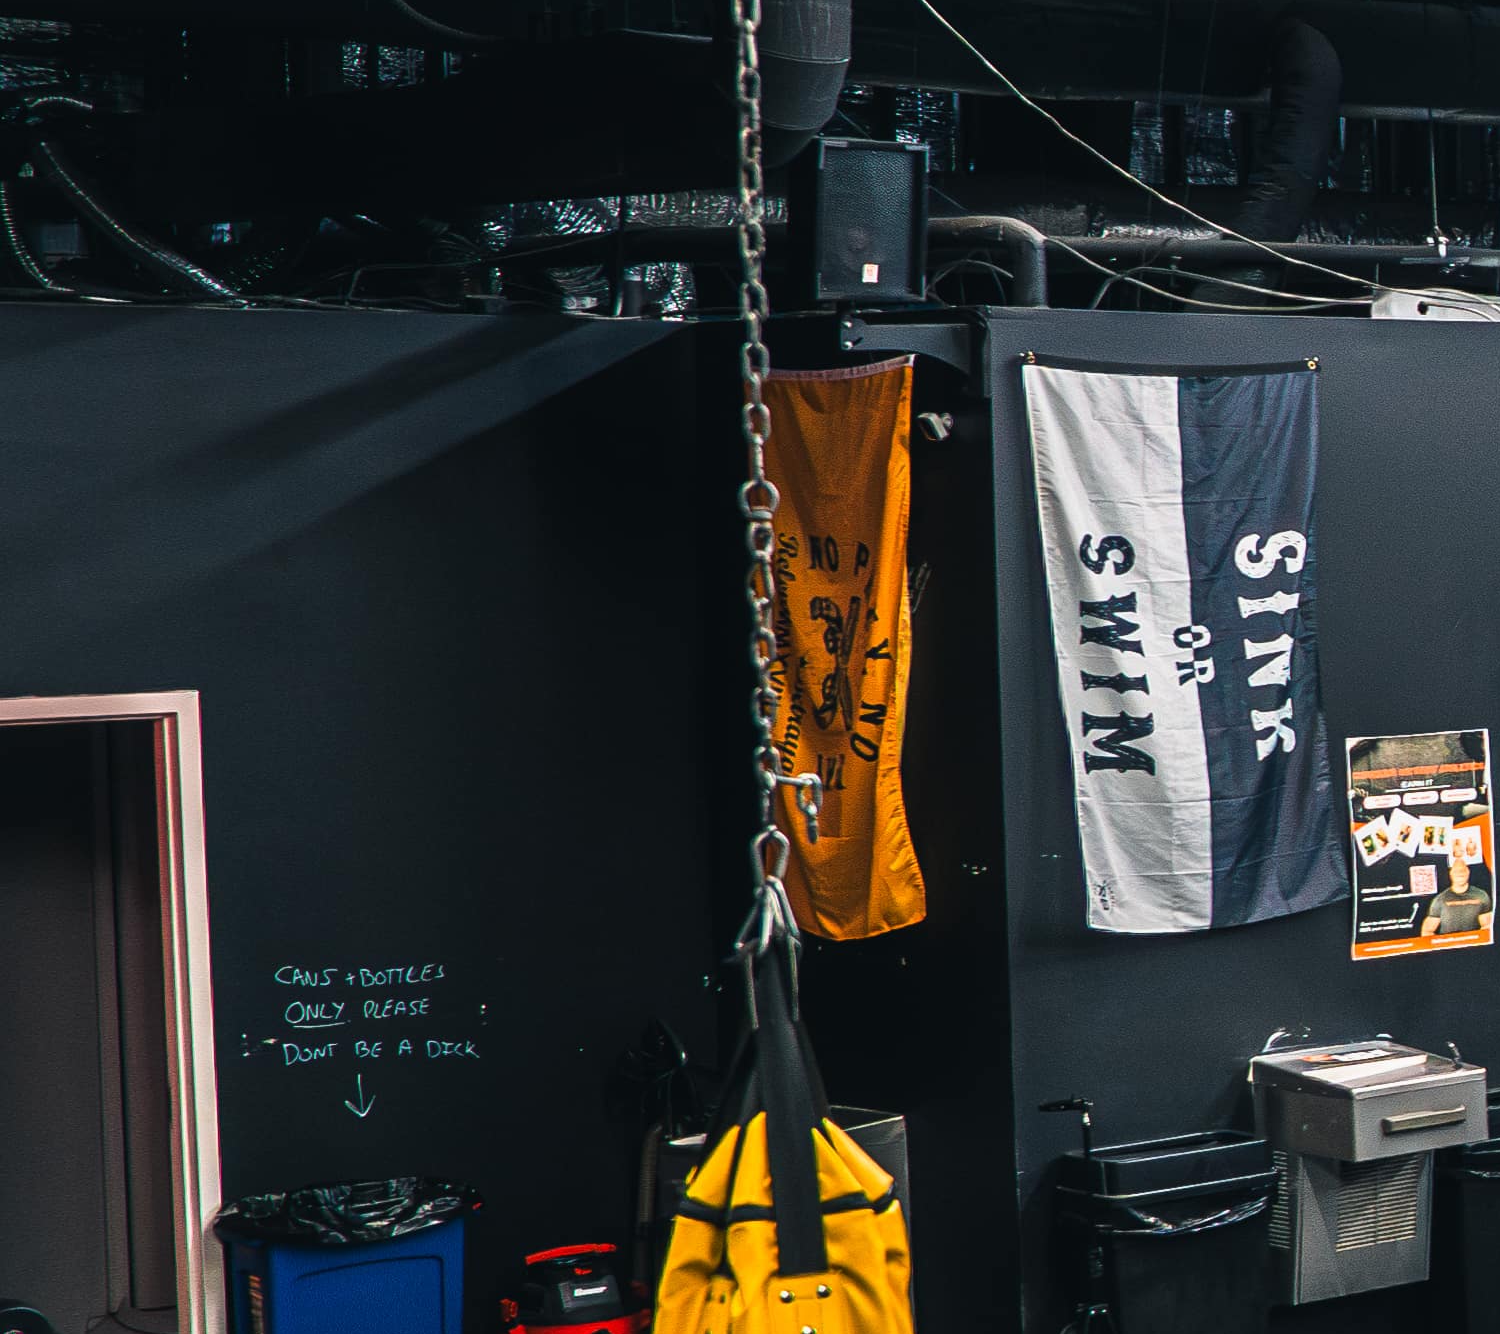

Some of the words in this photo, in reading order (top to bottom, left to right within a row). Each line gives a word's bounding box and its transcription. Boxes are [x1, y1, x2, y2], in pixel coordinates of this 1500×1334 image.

[1079, 533, 1157, 777] SWIM
[1173, 624, 1216, 687] OR
[1234, 529, 1308, 762] SINK
[274, 965, 339, 987] CANS
[359, 963, 446, 988] BOTTLES
[284, 1001, 345, 1025] ONLY
[363, 997, 430, 1019] PLEASE
[282, 1042, 340, 1066] DONT
[355, 1040, 383, 1059] BE
[398, 1038, 414, 1057] A
[426, 1040, 481, 1060] DICK
